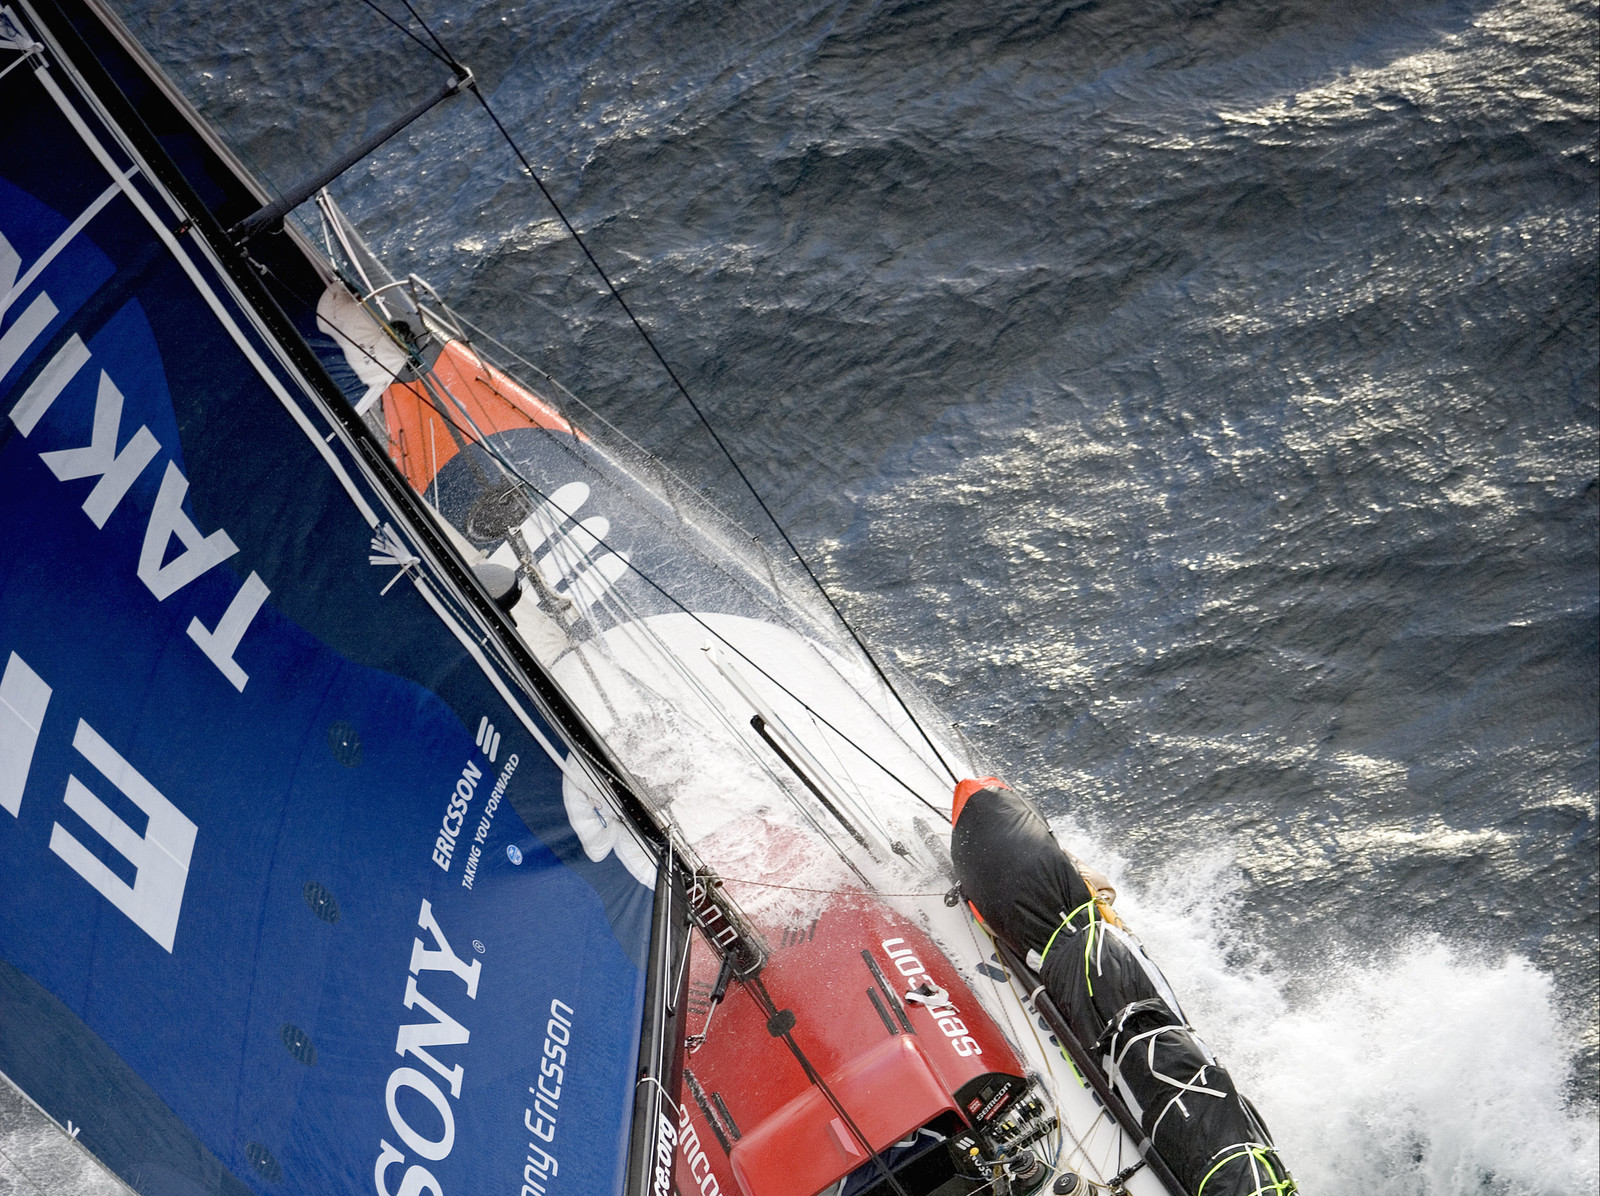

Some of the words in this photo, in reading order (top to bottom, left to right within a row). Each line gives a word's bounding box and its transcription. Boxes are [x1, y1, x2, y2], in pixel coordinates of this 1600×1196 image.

[432, 760, 483, 872] ERICSSON
[462, 845, 482, 890] TAKING
[474, 816, 491, 844] YOU
[485, 753, 520, 819] FORWARD
[525, 999, 574, 1142] Ericsson
[976, 1082, 1012, 1121] semcon
